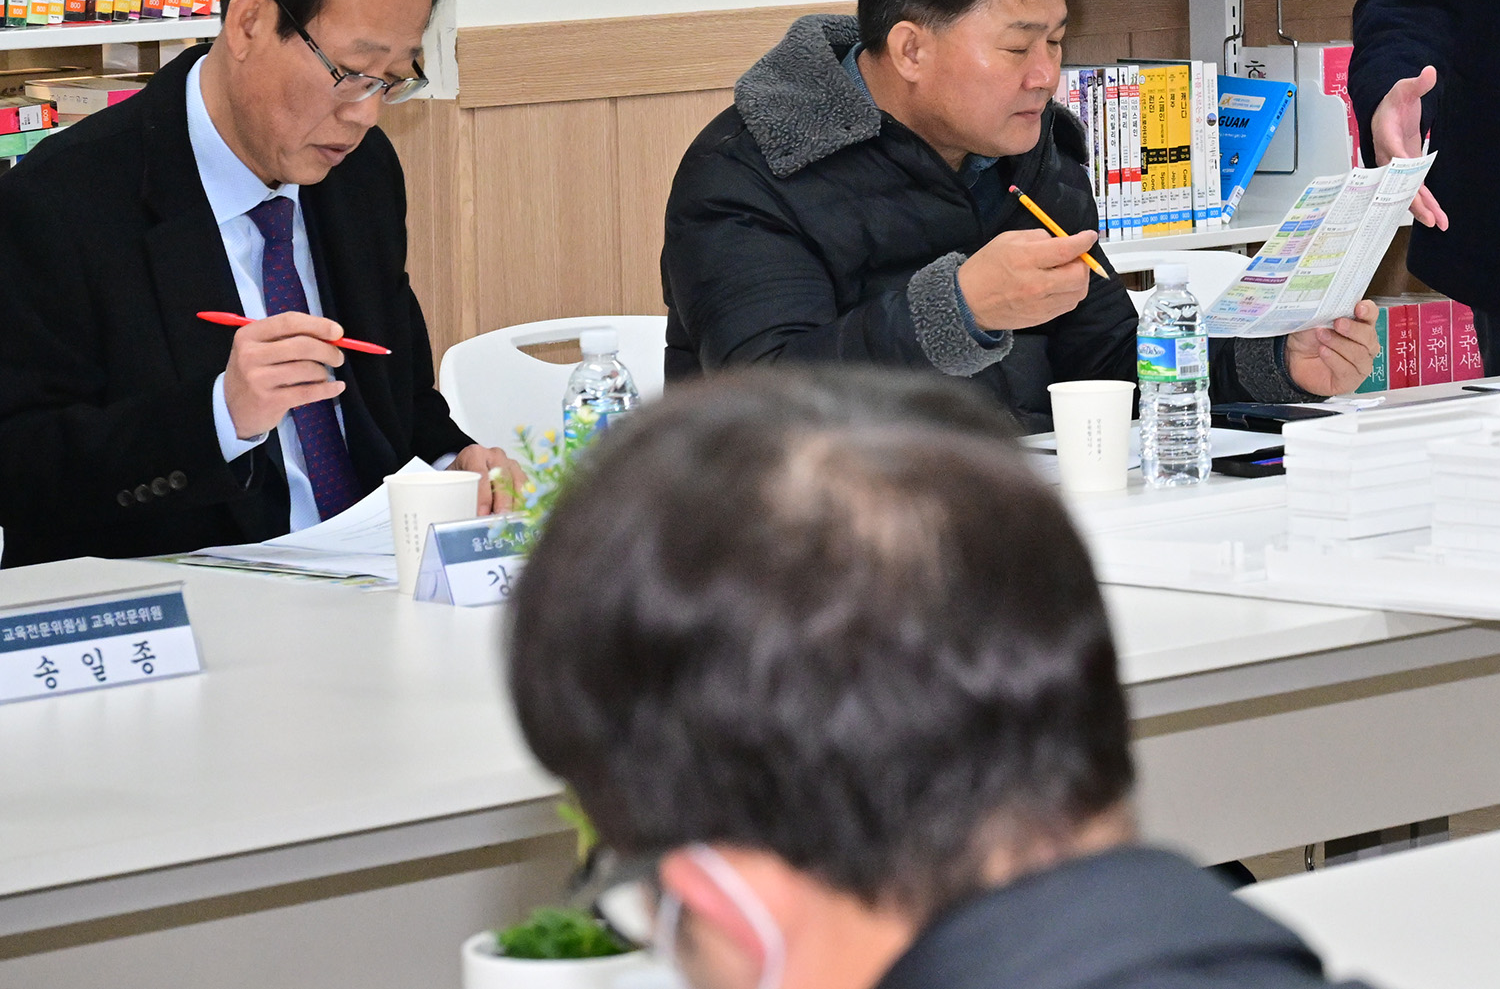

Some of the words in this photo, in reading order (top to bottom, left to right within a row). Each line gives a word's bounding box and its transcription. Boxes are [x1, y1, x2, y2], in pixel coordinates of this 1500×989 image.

[1218, 116, 1250, 129] GUAM
[1430, 326, 1443, 336] 보리
[1427, 337, 1448, 356] 국어
[1427, 355, 1448, 374] 사전
[2, 617, 88, 642] 교육전문위원실
[90, 605, 163, 629] 교육전문위원
